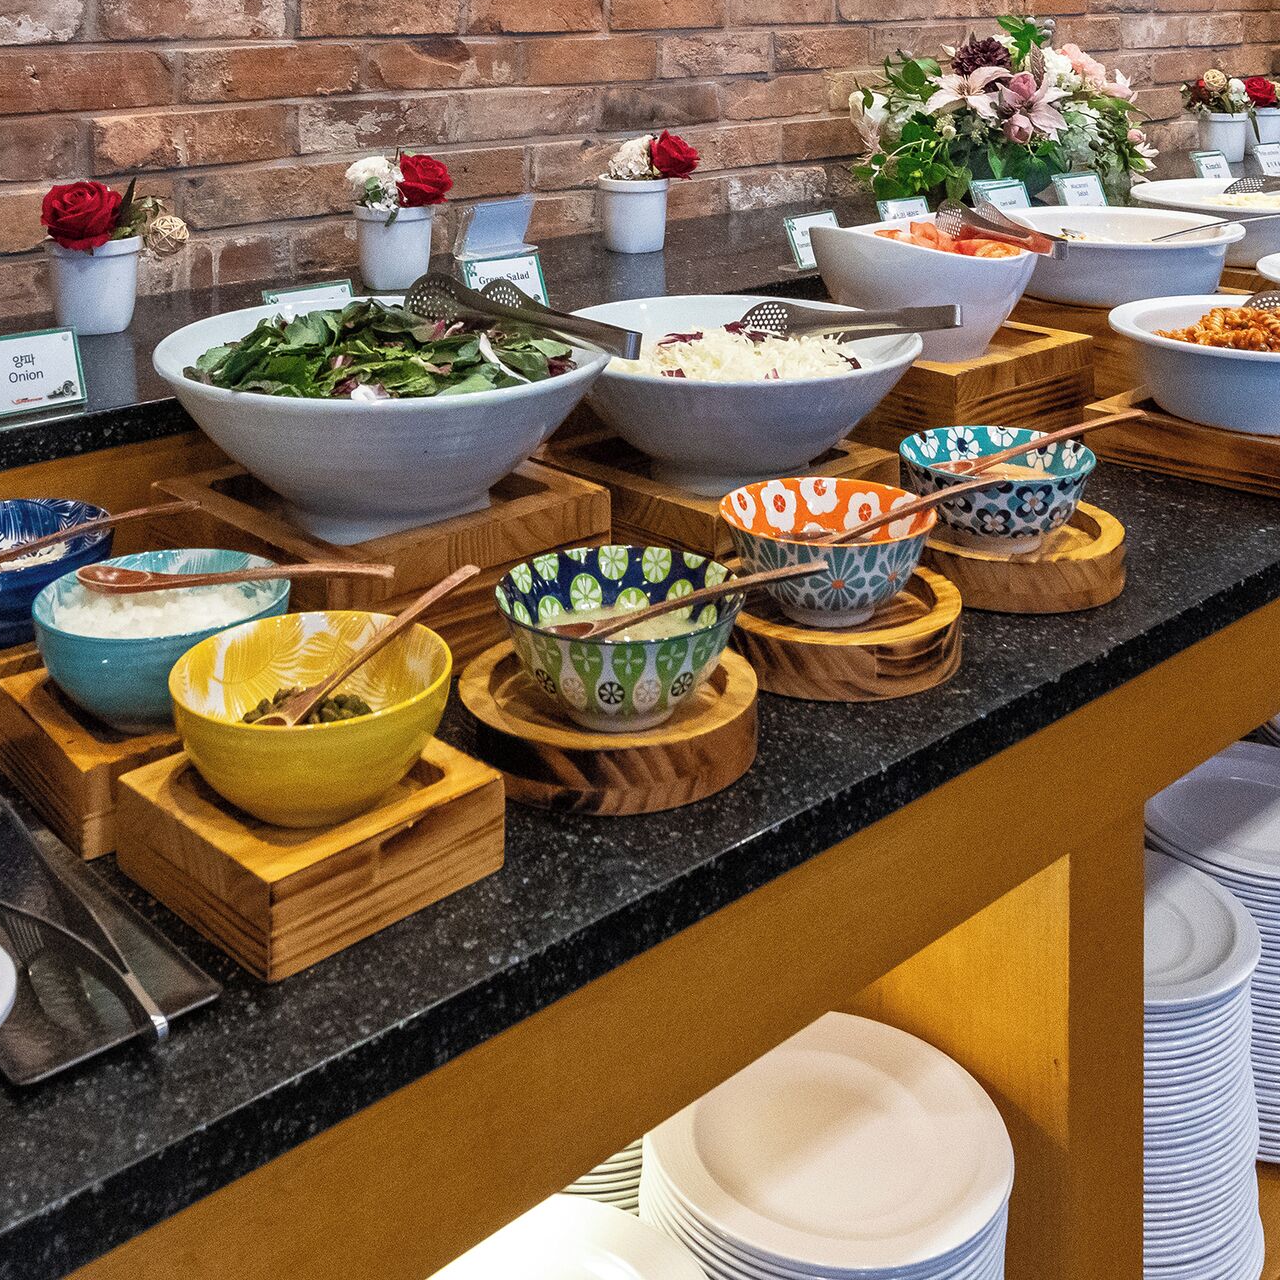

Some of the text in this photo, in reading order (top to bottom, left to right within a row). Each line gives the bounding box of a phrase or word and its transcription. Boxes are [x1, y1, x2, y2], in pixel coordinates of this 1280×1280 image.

[478, 271, 530, 285] Green Salad
[12, 353, 36, 368] 양파
[8, 369, 44, 383] Onion
